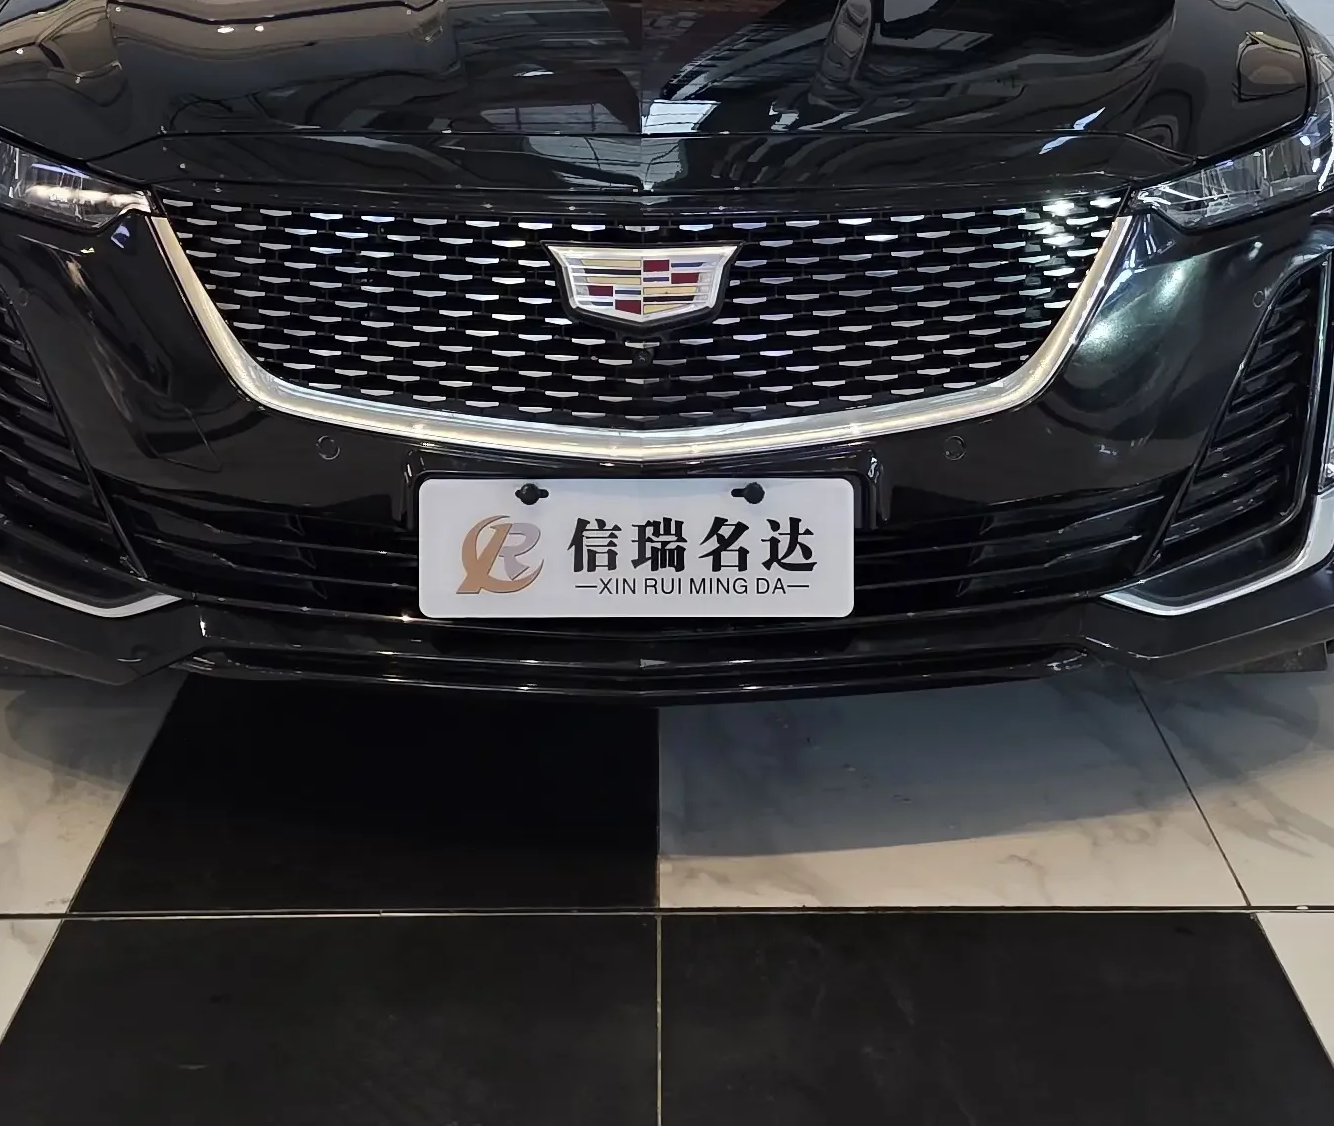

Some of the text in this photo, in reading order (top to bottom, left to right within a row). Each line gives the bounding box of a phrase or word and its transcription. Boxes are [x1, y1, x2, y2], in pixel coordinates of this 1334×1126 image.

[566, 516, 818, 573] 信瑞名达
[598, 577, 787, 595] XIN RUI MING DA
